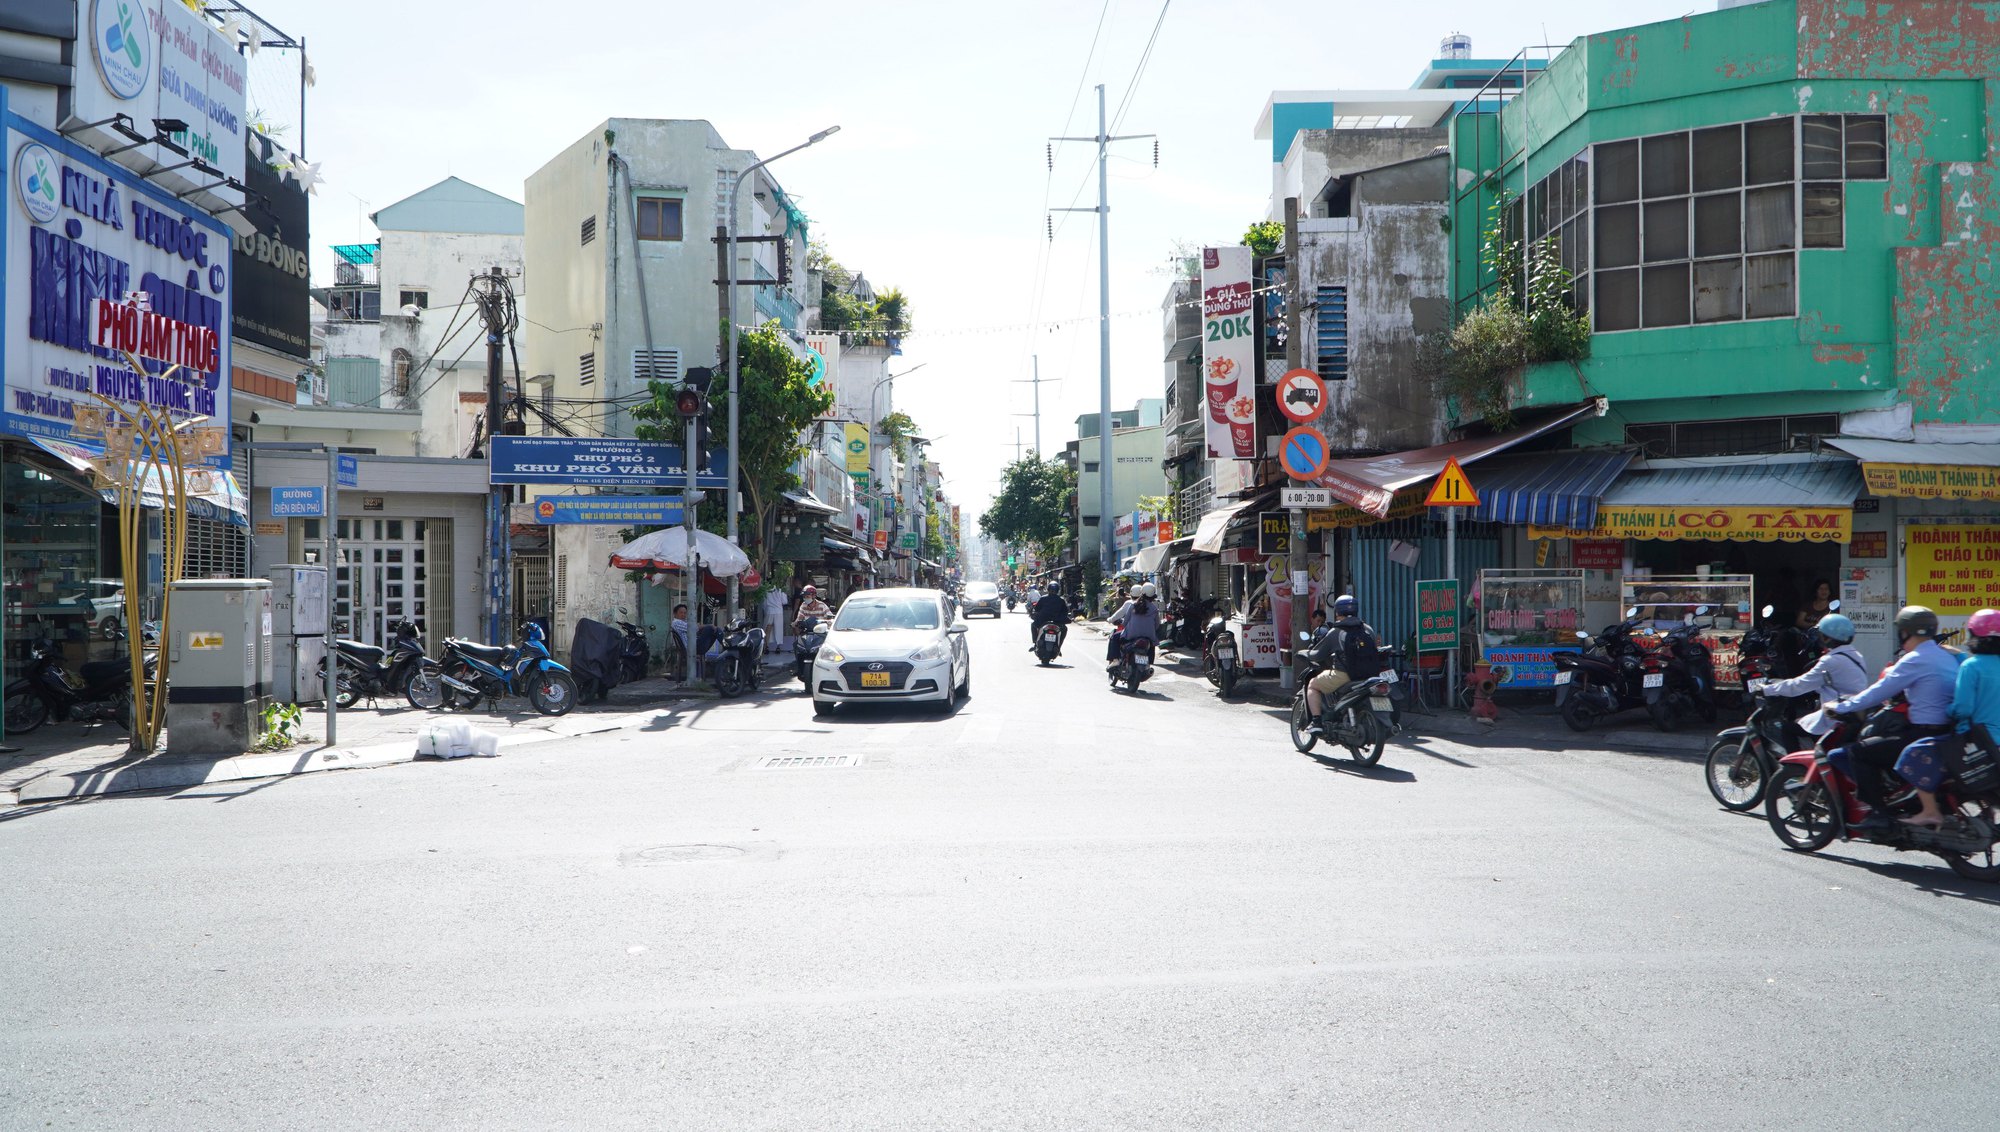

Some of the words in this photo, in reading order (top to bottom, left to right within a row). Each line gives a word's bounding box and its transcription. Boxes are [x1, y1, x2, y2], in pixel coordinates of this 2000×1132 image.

[104, 55, 122, 73] MINH
[62, 166, 124, 230] NHÀ
[132, 216, 208, 268] THUỐC
[258, 224, 308, 280] ĐỒNG
[1217, 284, 1236, 300] GIÁ
[1204, 302, 1231, 314] DÙNG
[1233, 294, 1250, 308] THỬ
[1206, 316, 1252, 342] 20K
[174, 320, 218, 379] THỰC
[611, 453, 643, 462] PHỐ
[514, 464, 560, 472] KHU
[566, 463, 611, 473] PHỐ
[618, 464, 661, 474] VĂN
[1900, 465, 1937, 485] HOÀNH
[1941, 468, 1978, 486] THÁNH
[1982, 470, 1996, 487] LÁ
[282, 490, 313, 498] ĐƯỜNG
[1920, 486, 1942, 496] TIẾU
[1981, 489, 1994, 497] MÌ
[291, 503, 306, 513] BIÊN
[307, 500, 320, 512] PHỦ
[1263, 515, 1289, 534] TRÀ
[1612, 509, 1655, 527] THÁNH
[1660, 510, 1676, 527] LÁ
[1678, 510, 1732, 528] CÔ
[1746, 510, 1844, 529] TÁM
[1658, 529, 1673, 537] MÌ
[1686, 530, 1720, 538] BÁNH
[1777, 530, 1806, 539] BÚN
[1913, 528, 1960, 544] HOÀNH
[1934, 546, 1972, 562] CHÁO
[1930, 570, 1946, 579] NUI
[1956, 568, 1970, 579] HỦ
[1972, 568, 1993, 579] TIẾU
[1920, 583, 1946, 593] BÁNH
[1949, 584, 1975, 593] CANH
[1940, 597, 1966, 607] Quán
[1970, 597, 1983, 607] Cô
[1436, 614, 1454, 628] TÁM
[1256, 645, 1276, 653] 100
[1490, 652, 1525, 663] HOÀNH
